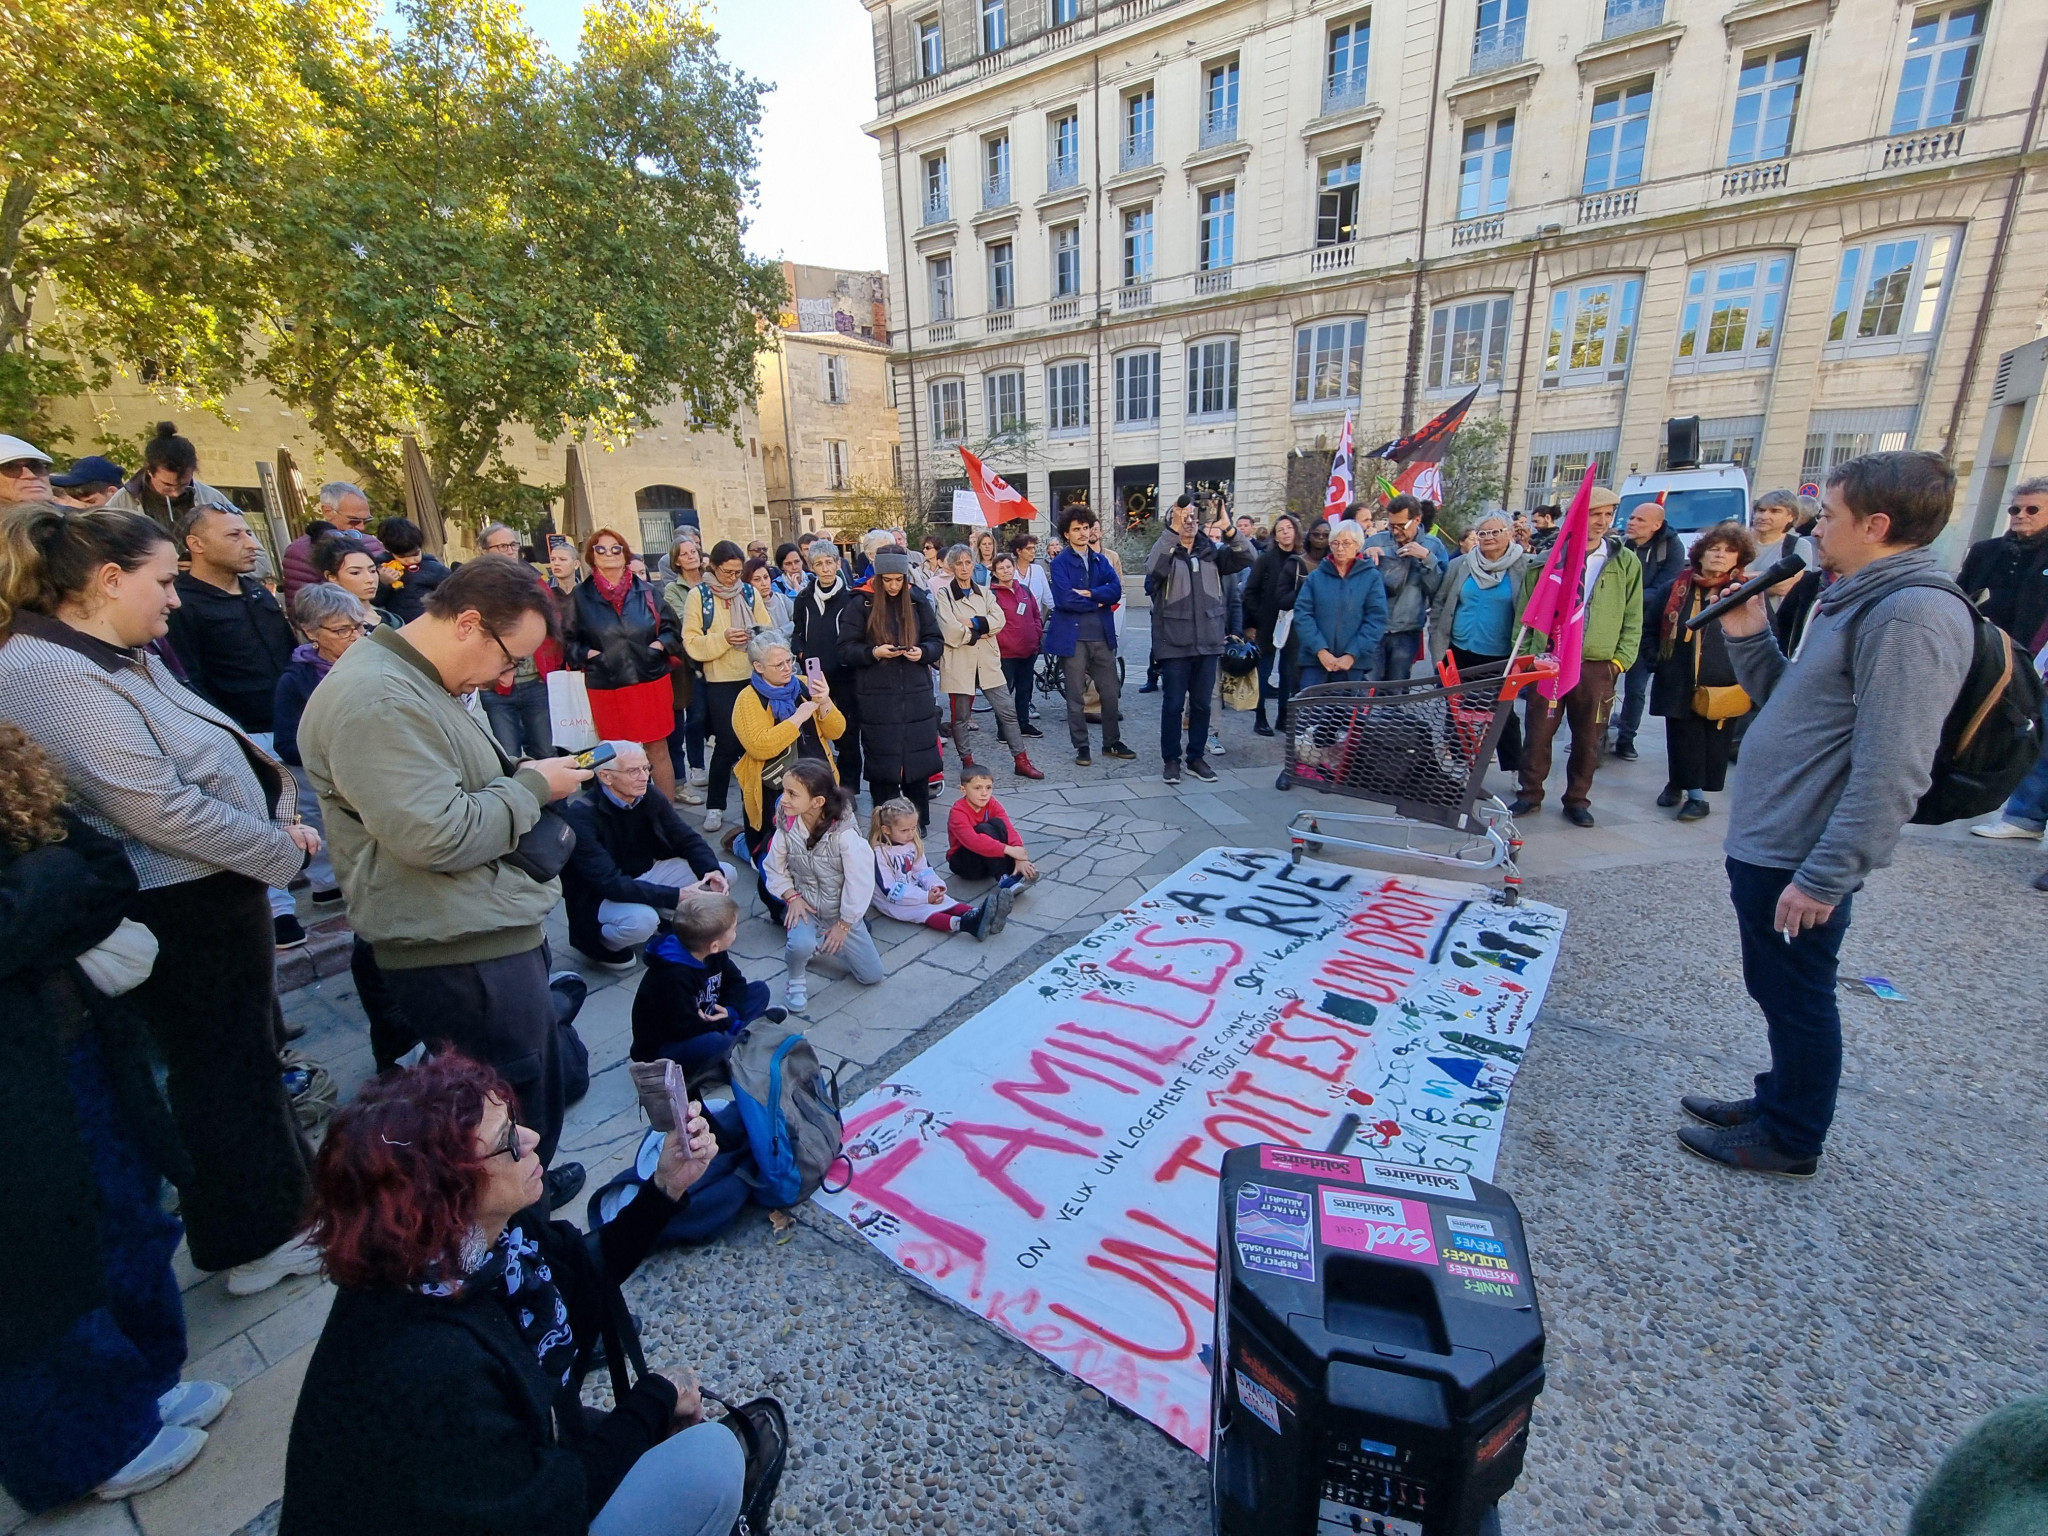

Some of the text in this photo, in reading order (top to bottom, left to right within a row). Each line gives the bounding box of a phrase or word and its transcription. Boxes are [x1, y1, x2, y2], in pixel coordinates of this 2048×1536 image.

[1166, 890, 1225, 917] A
[1225, 863, 1352, 937] RUE
[1345, 880, 1449, 959] DROIT
[1312, 949, 1415, 1004] UN
[1208, 1004, 1282, 1080] TOUT LE MONDE
[1254, 998, 1372, 1082] EST
[825, 923, 1244, 1262] FAMILLES
[1017, 1238, 1051, 1269] ON
[1057, 1181, 1097, 1223] VEUX
[1096, 1149, 1124, 1176] UN
[1127, 1076, 1192, 1147] LOGEMENT
[1215, 1010, 1256, 1045] COMME
[1272, 1152, 1350, 1176] Solidaires
[1375, 1167, 1460, 1191] Solidaires
[1261, 1203, 1271, 1212] ET
[1272, 1205, 1289, 1214] FAC
[1289, 1207, 1299, 1216] LA
[1333, 1197, 1395, 1217] Solidaires
[1365, 1223, 1431, 1254] Sud
[1455, 1237, 1502, 1253] GRÈVES
[1272, 1259, 1298, 1270] RESPECT
[1442, 1249, 1509, 1269] BLOCAGES
[1049, 1209, 1216, 1362] UN
